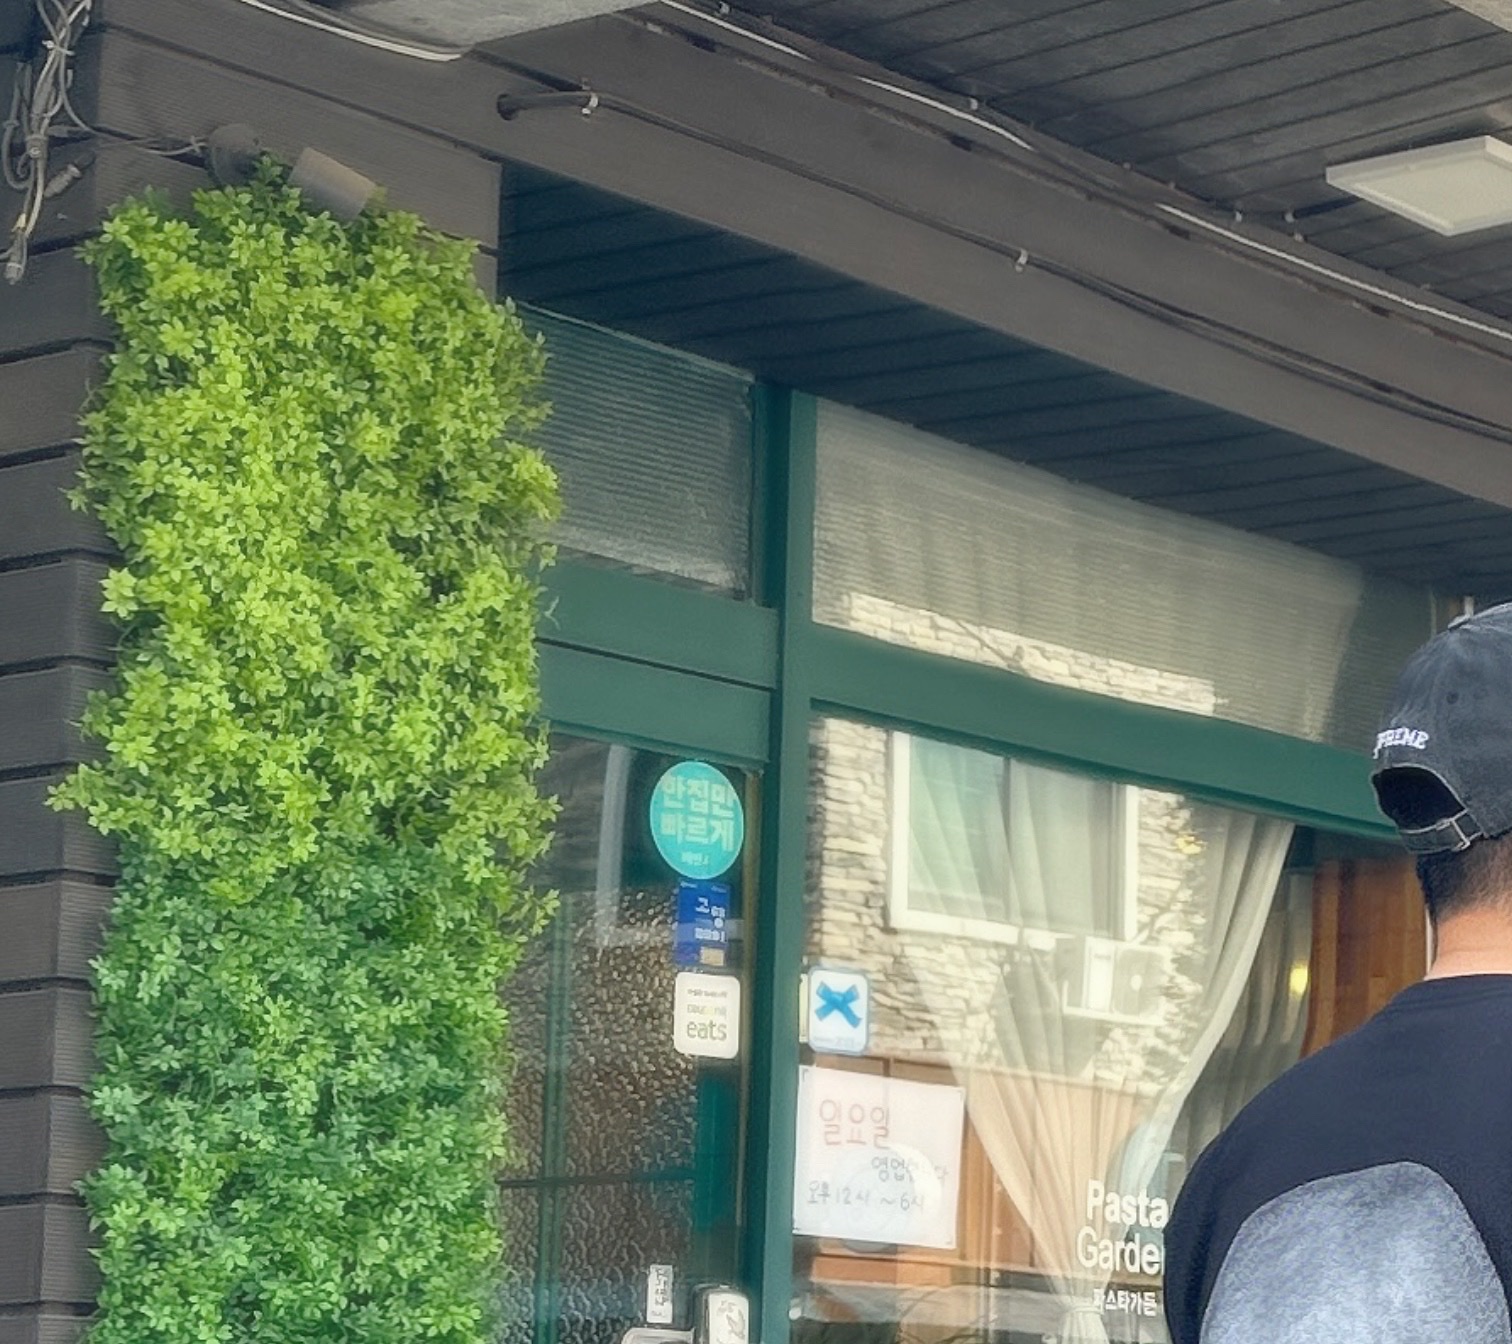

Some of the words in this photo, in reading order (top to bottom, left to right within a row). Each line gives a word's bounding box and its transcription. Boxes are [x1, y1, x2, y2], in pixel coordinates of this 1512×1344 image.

[1373, 727, 1429, 760] PREME
[660, 813, 735, 852] 빠르게
[686, 1019, 728, 1041] eats
[819, 1098, 891, 1150] 일요일
[807, 1180, 831, 1204] 오후
[1086, 1179, 1170, 1228] Pasta
